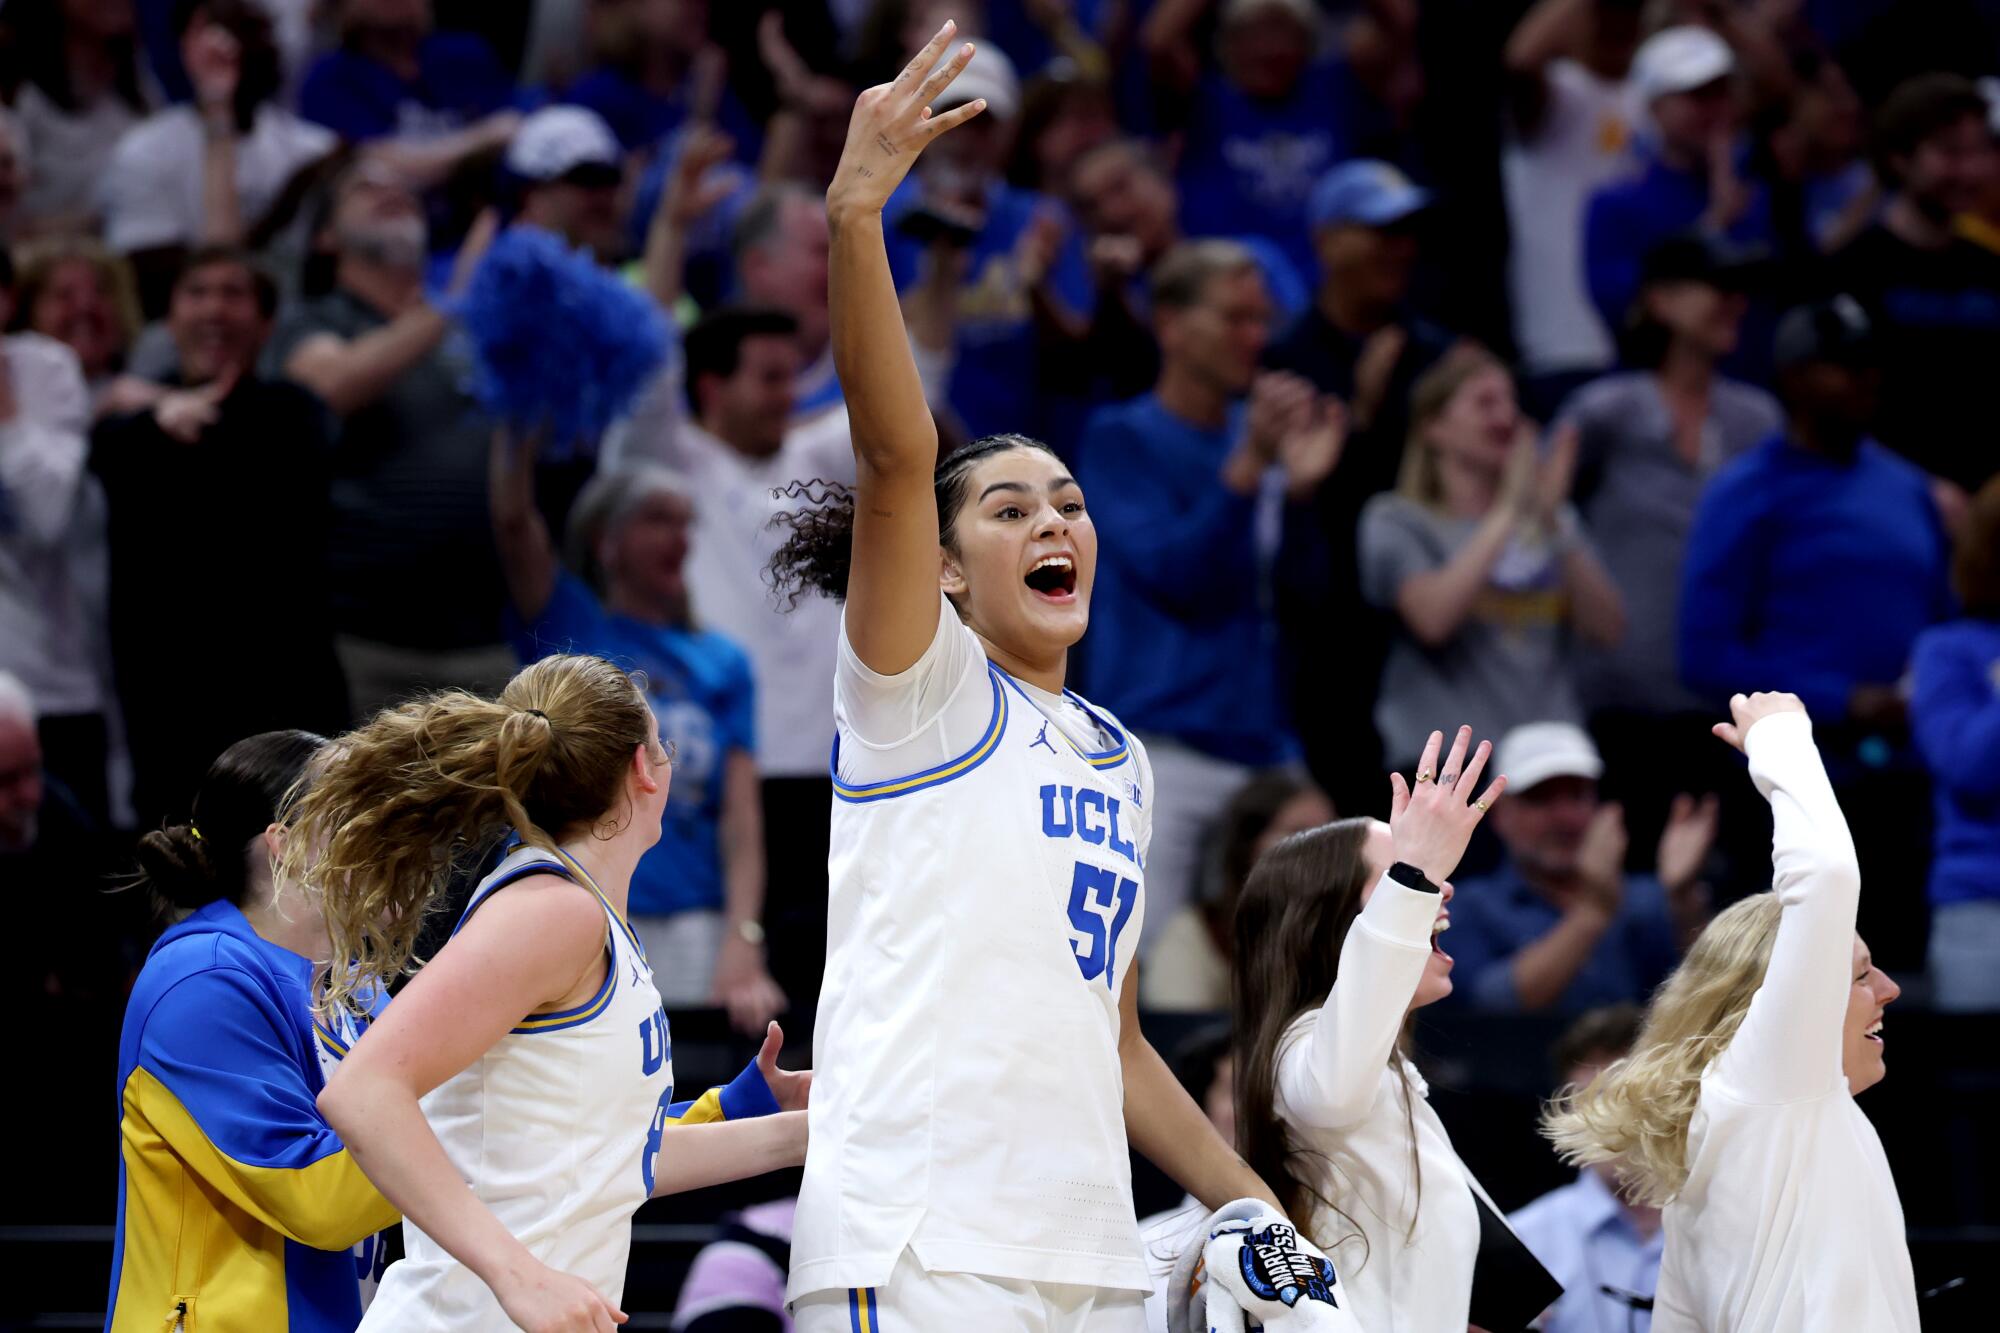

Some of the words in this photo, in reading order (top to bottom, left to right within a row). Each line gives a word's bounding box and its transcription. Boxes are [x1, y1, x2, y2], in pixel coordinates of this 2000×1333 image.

[1039, 783, 1143, 869] UCL
[1067, 860, 1138, 991] 51
[642, 1084, 673, 1199] 8
